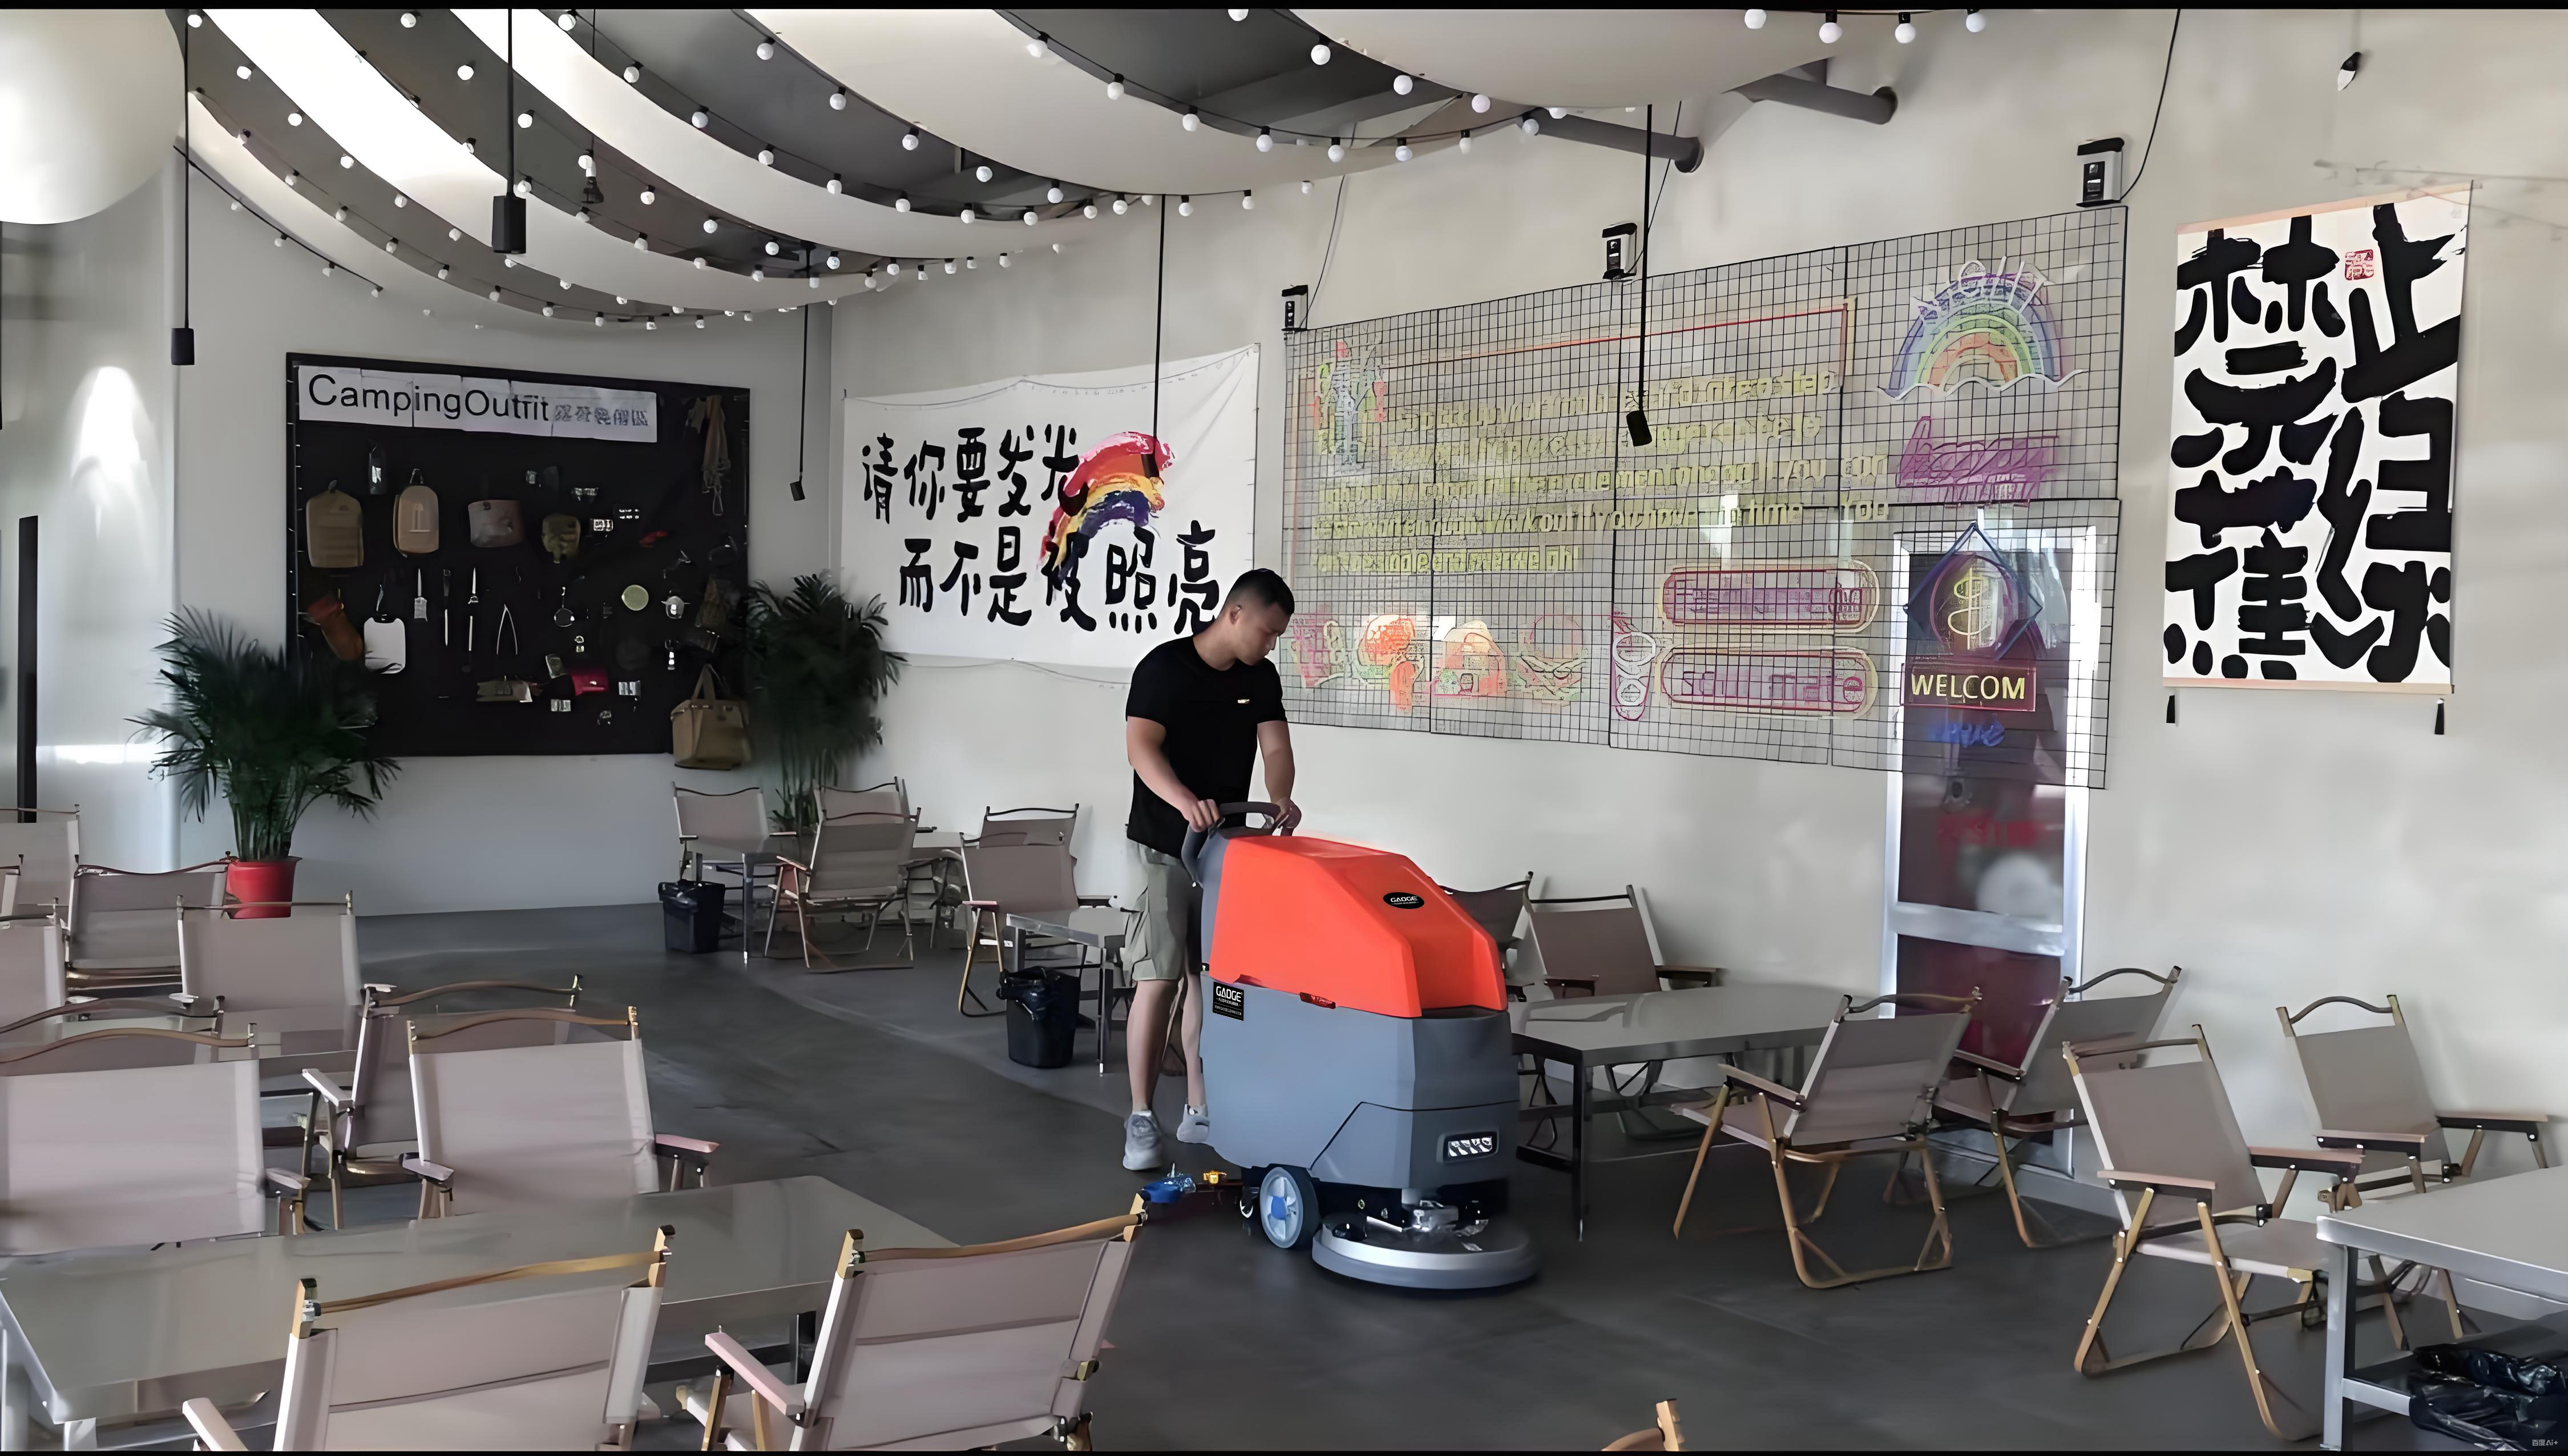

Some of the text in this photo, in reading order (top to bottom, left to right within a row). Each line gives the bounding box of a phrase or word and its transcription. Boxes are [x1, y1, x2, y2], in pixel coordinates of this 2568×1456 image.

[308, 373, 550, 423] CampingOutfit
[899, 520, 1220, 634] 而不是被照亮
[1911, 673, 2026, 700] WELCOM
